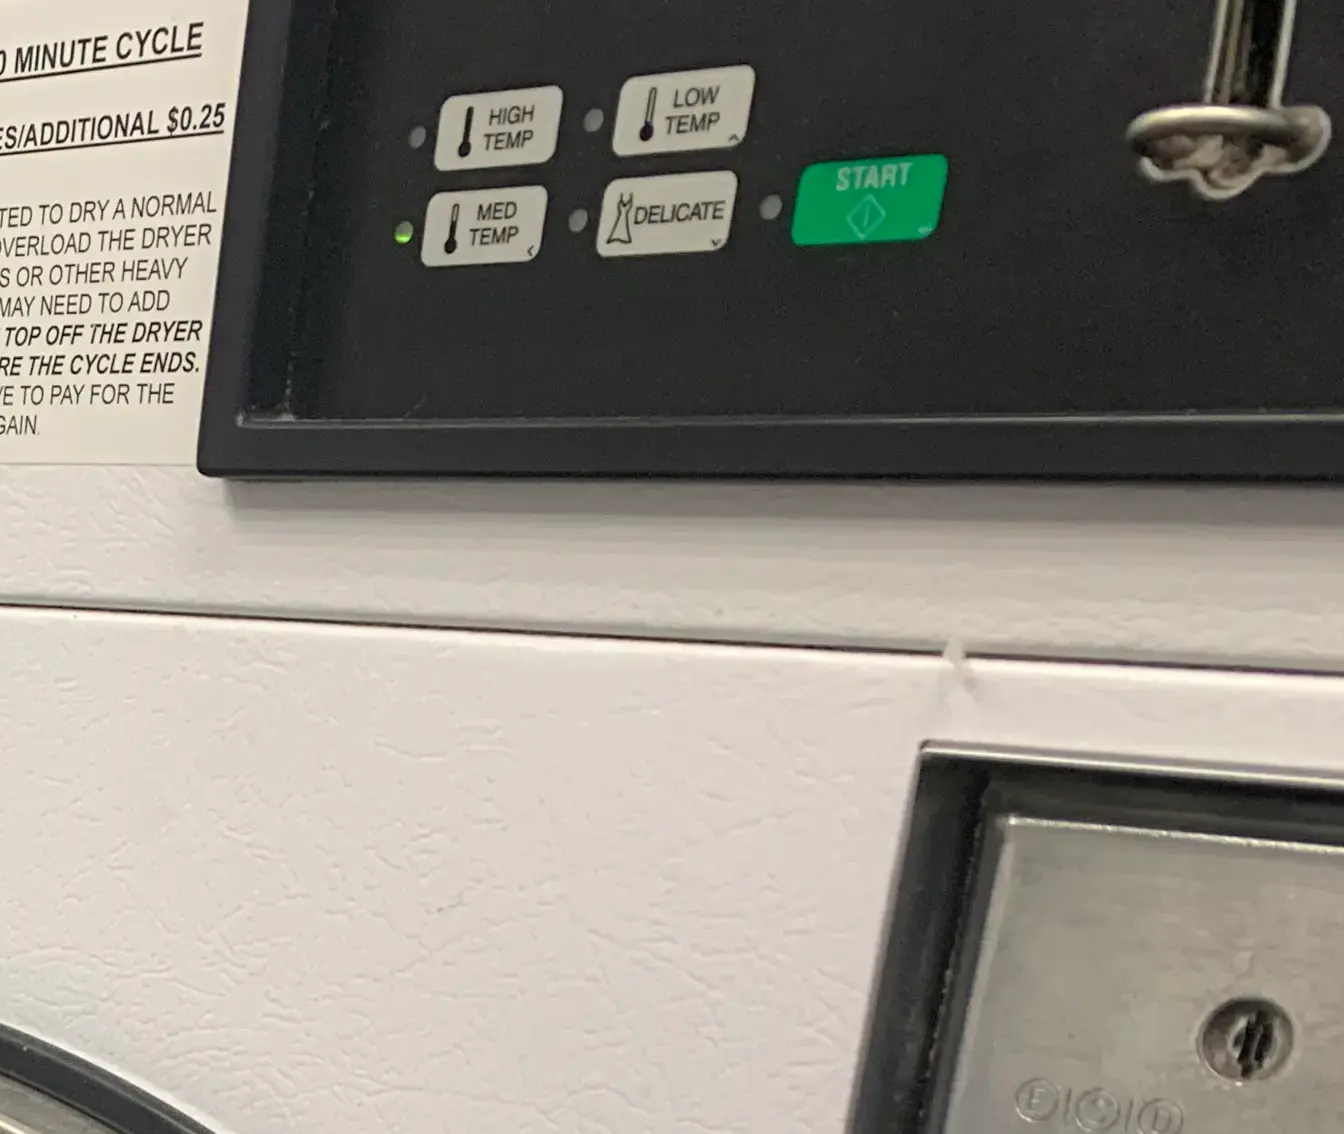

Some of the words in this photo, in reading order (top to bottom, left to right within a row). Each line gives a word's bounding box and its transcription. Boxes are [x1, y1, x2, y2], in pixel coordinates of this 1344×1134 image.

[14, 35, 109, 74] MINUTE
[116, 21, 204, 60] CYCLE
[672, 86, 720, 108] LOW
[167, 102, 226, 136] $0.25
[488, 105, 535, 126] HIGH
[665, 111, 720, 135] TEMP
[483, 129, 534, 151] TEMP
[836, 162, 913, 191] START
[38, 203, 63, 226] TO
[69, 199, 110, 224] DRY
[112, 198, 126, 220] A
[131, 190, 217, 219] NORMAL
[476, 201, 517, 222] MED
[633, 199, 725, 226] DELICATE
[97, 228, 136, 252] THE
[141, 223, 212, 250] DRYER
[468, 225, 519, 247] TEMP
[16, 265, 44, 288] OR
[49, 261, 116, 286] OTHER
[120, 256, 189, 282] HEAVY
[40, 293, 92, 316] NEED
[98, 291, 124, 314] TO
[127, 289, 170, 313] ADD
[5, 325, 42, 348] TOP
[45, 324, 85, 346] OFF
[90, 322, 129, 345] THE
[131, 319, 204, 344] DRYER
[28, 354, 66, 376] THE
[70, 352, 137, 375] CYCLE
[139, 351, 200, 374] ENDS.
[20, 384, 44, 406] TO
[49, 384, 86, 406] PAY
[89, 383, 130, 405] FOR
[136, 382, 176, 404] THE
